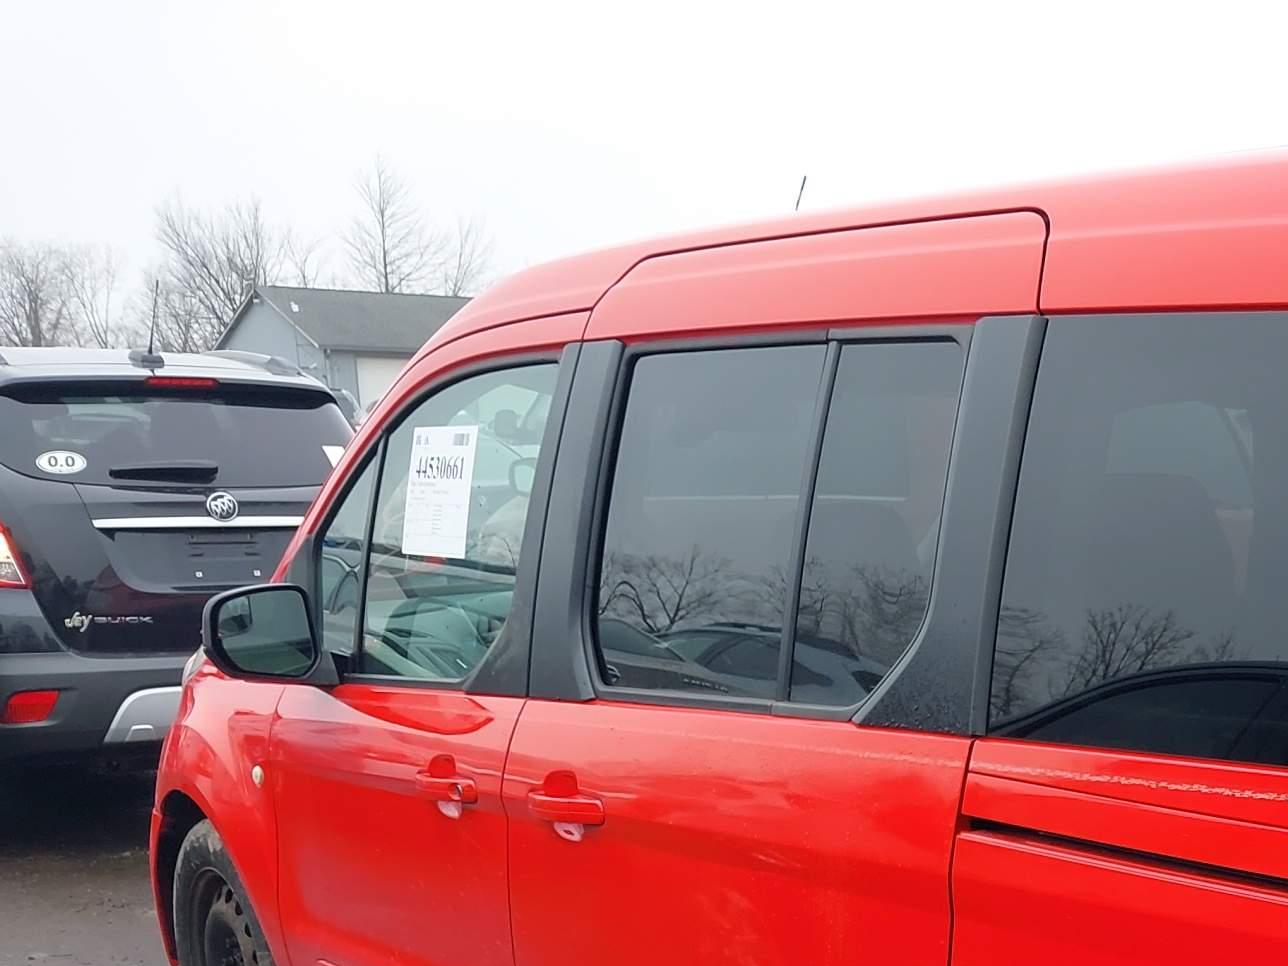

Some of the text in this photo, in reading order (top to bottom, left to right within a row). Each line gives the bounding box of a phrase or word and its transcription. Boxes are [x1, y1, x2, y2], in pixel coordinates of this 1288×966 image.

[47, 455, 76, 468] 0.0
[415, 455, 465, 480] 44530661
[93, 616, 154, 624] BUICK
